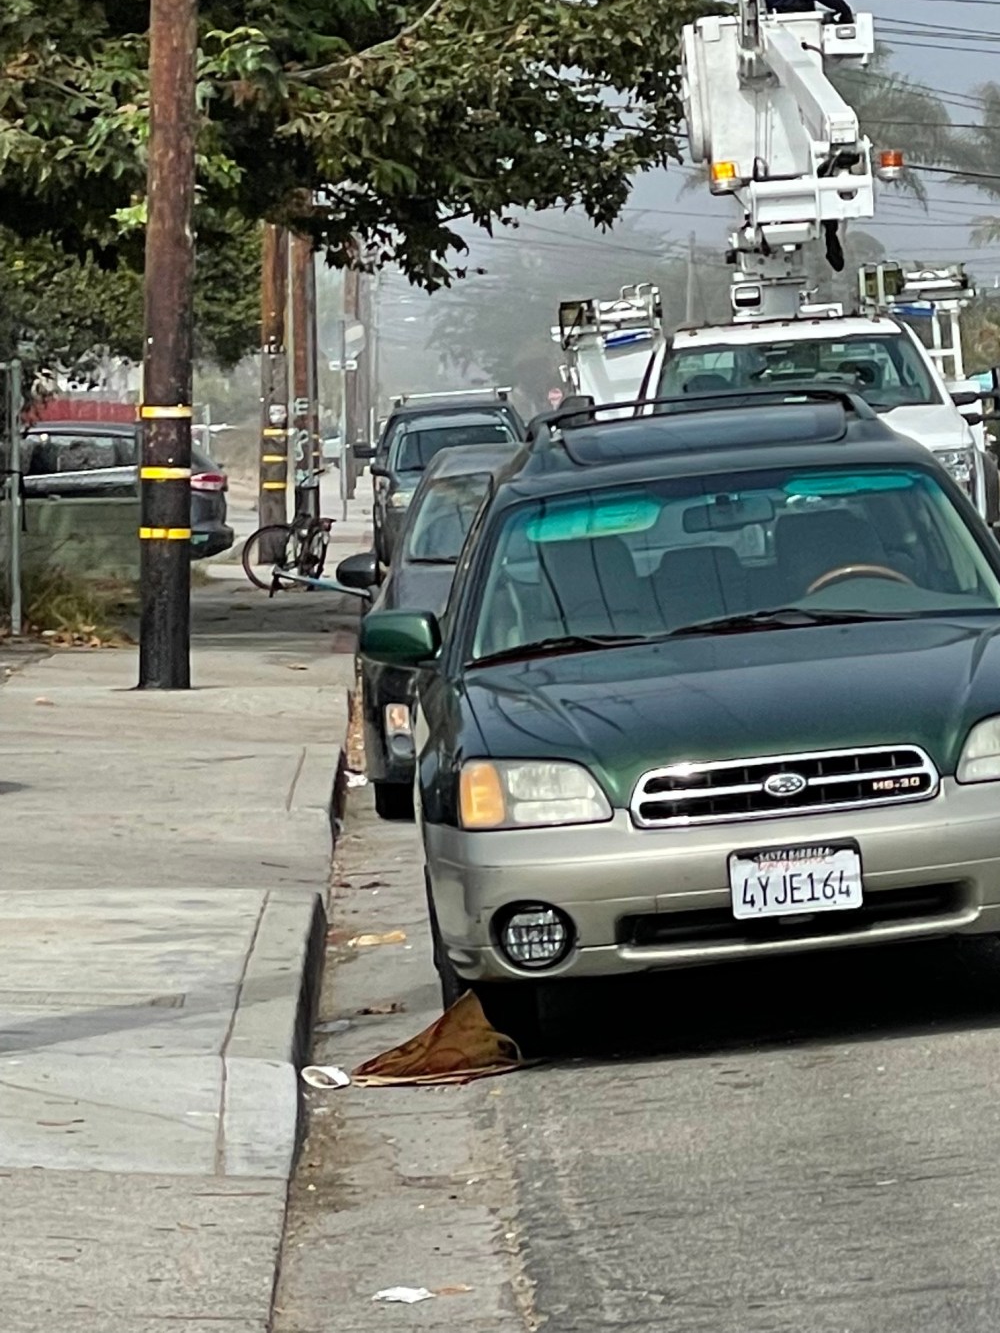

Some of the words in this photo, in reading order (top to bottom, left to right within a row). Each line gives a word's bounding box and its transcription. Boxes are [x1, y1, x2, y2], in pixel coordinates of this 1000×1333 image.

[759, 849, 787, 861] SANTA
[788, 846, 831, 861] BARBARA
[742, 869, 852, 908] 4YJE164
